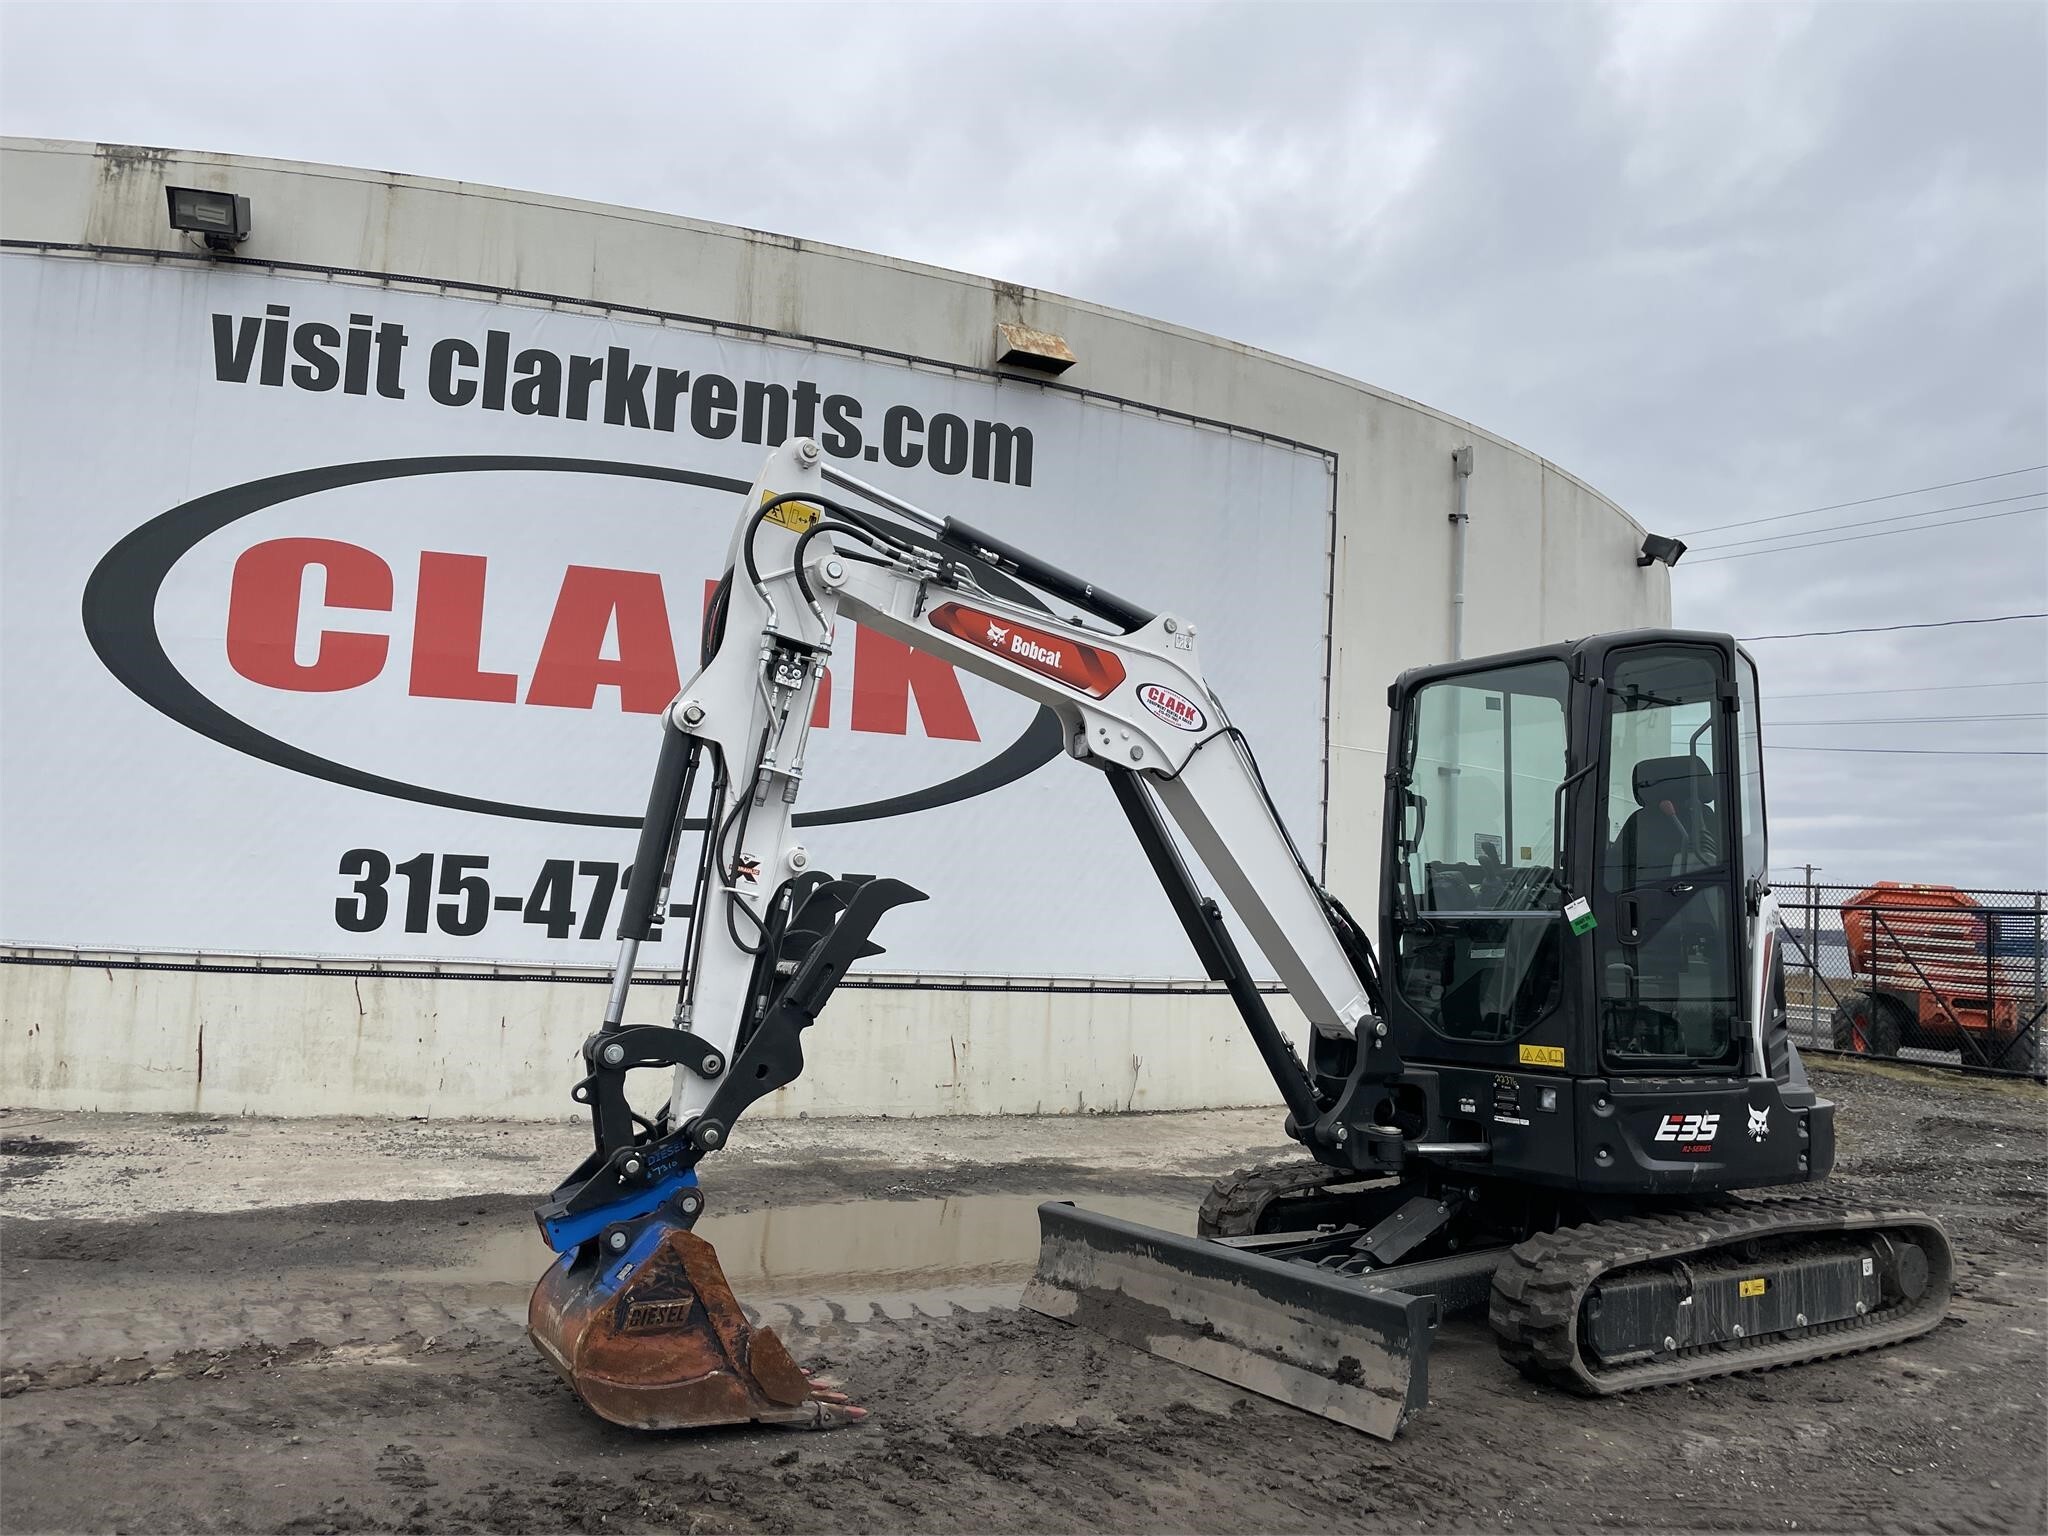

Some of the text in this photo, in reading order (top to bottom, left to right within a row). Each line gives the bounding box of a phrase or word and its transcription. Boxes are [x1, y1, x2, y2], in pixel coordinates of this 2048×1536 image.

[212, 304, 1034, 488] visit clarkrents.com
[227, 538, 981, 742] CLAK
[1011, 634, 1061, 668] Bobcat
[1148, 687, 1196, 721] CLARK
[1654, 1114, 1721, 1141] E35
[628, 1305, 686, 1329] DIESEL
